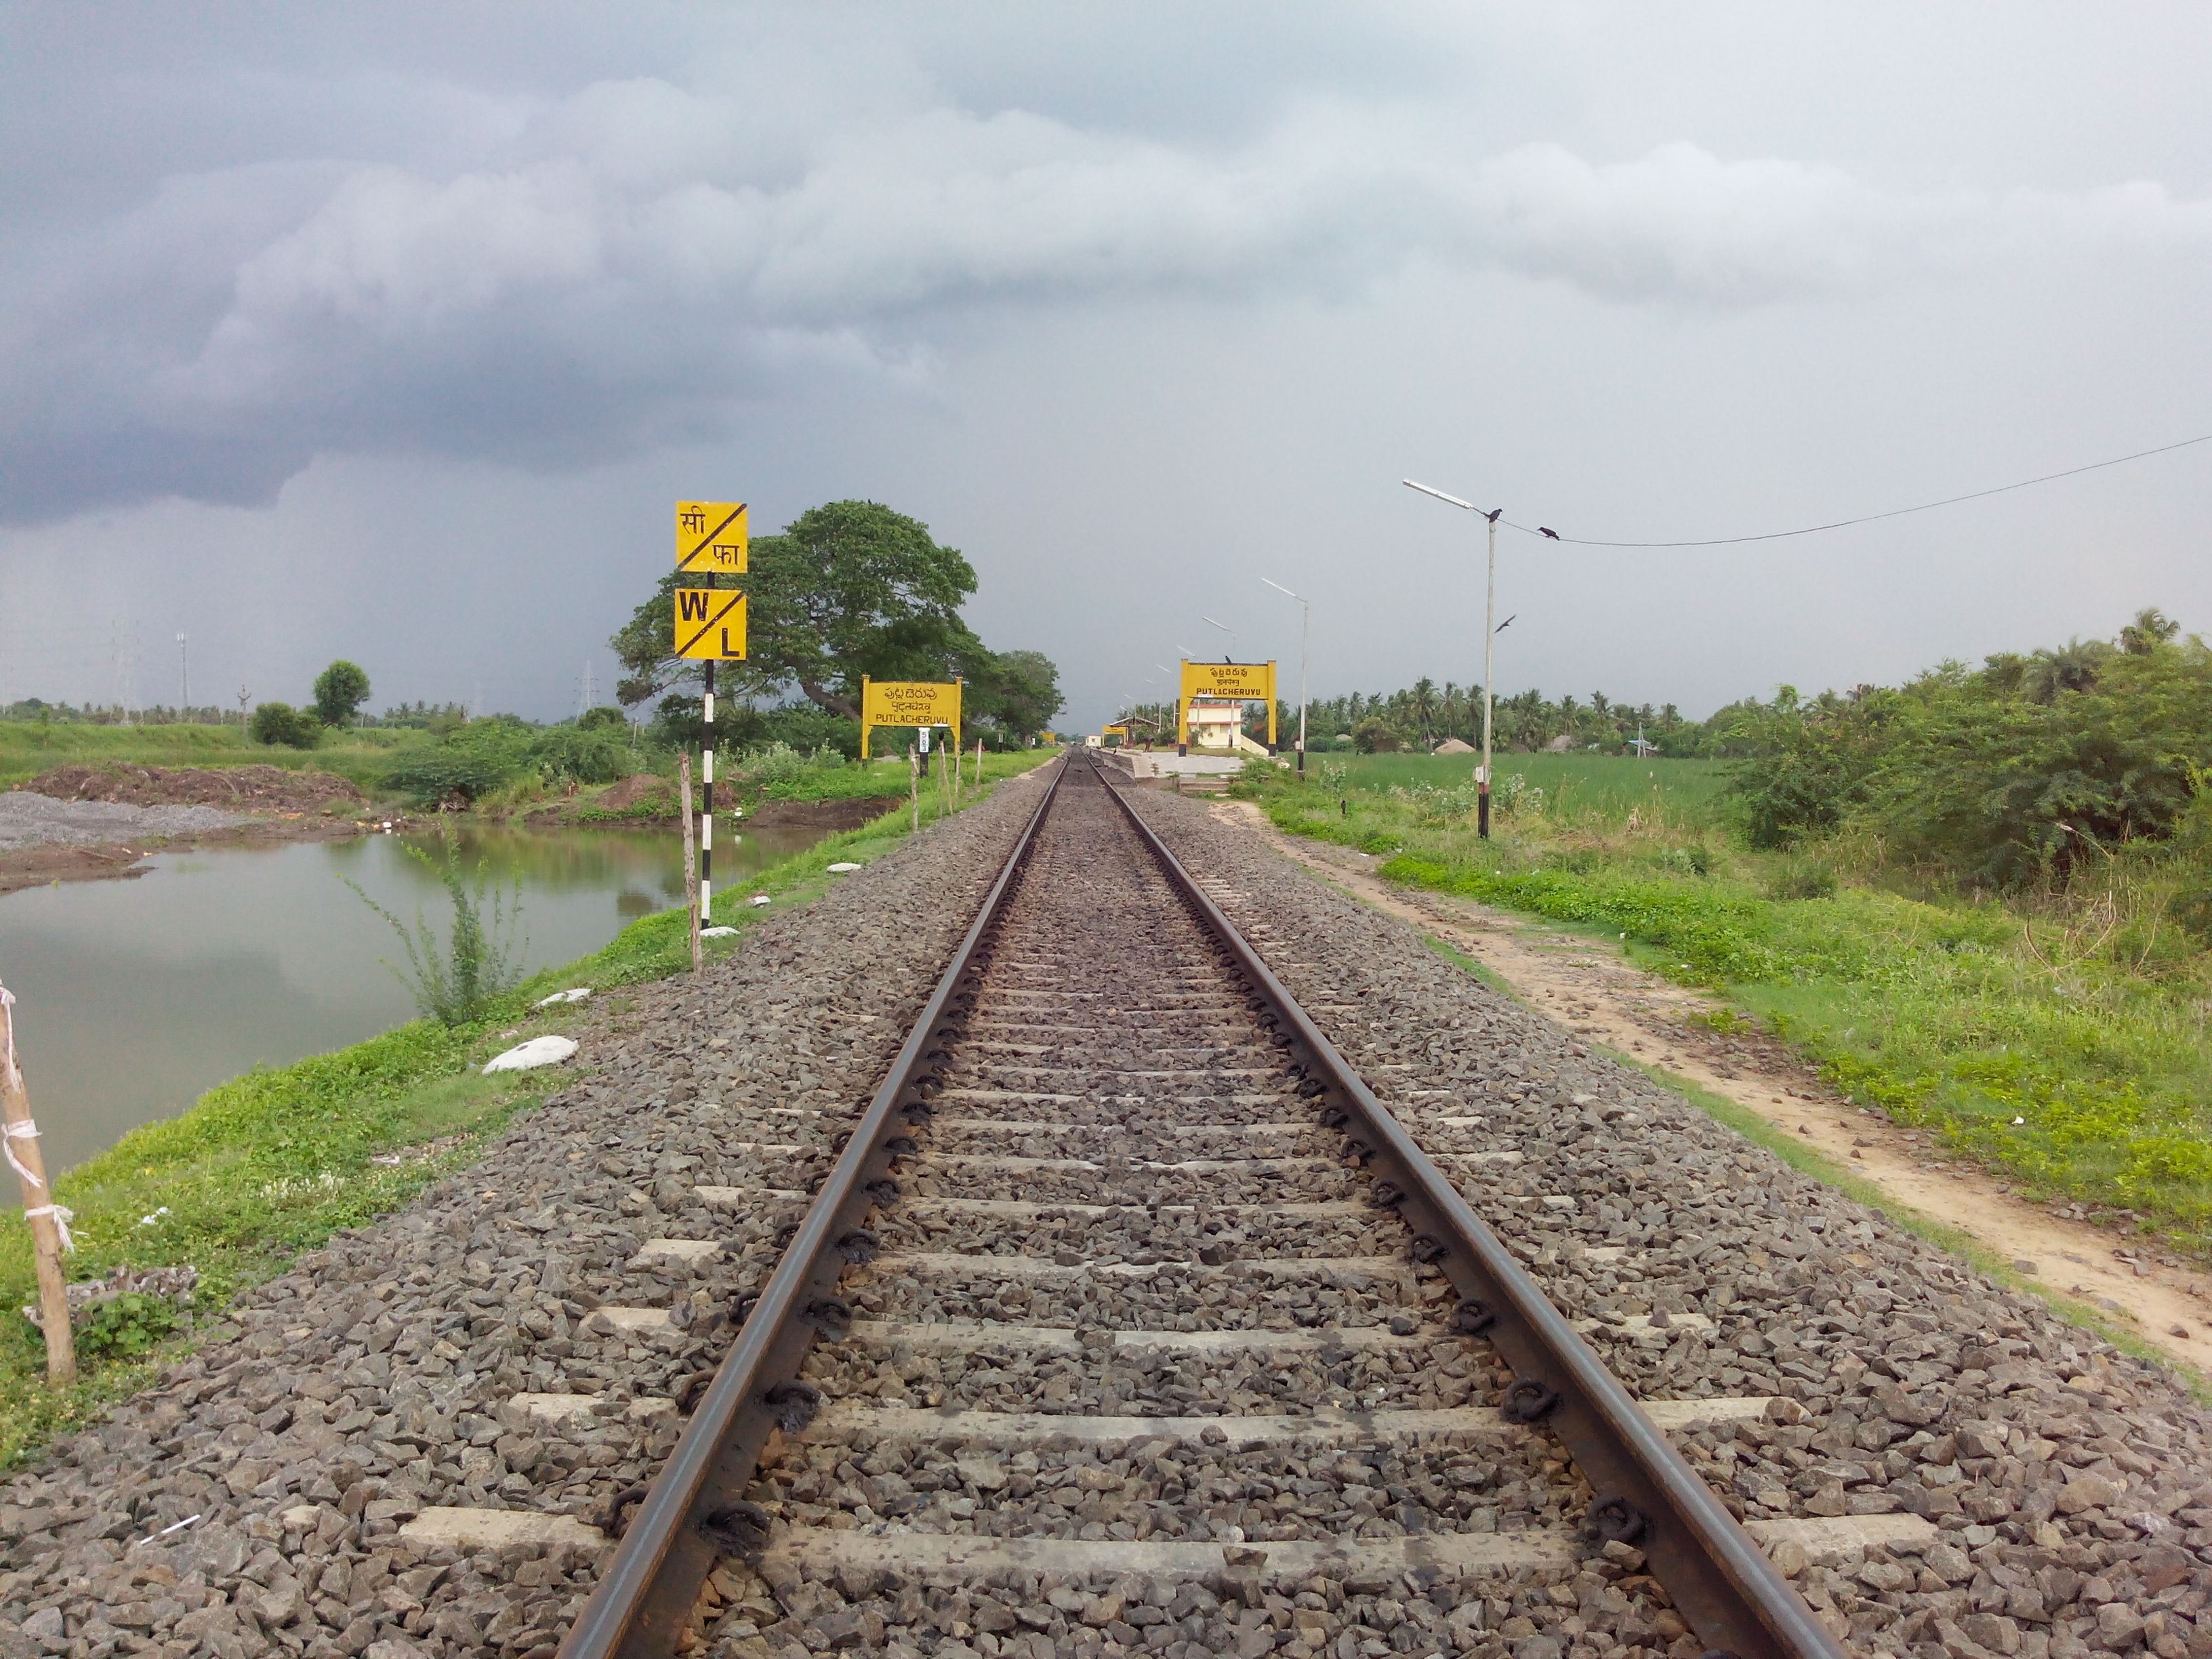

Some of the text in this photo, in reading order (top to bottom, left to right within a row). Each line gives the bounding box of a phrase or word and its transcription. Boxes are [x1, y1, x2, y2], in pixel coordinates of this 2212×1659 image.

[713, 545, 739, 565] फा
[679, 592, 709, 621] W
[722, 628, 740, 657] L
[876, 714, 948, 724] PUTLACHERUVU
